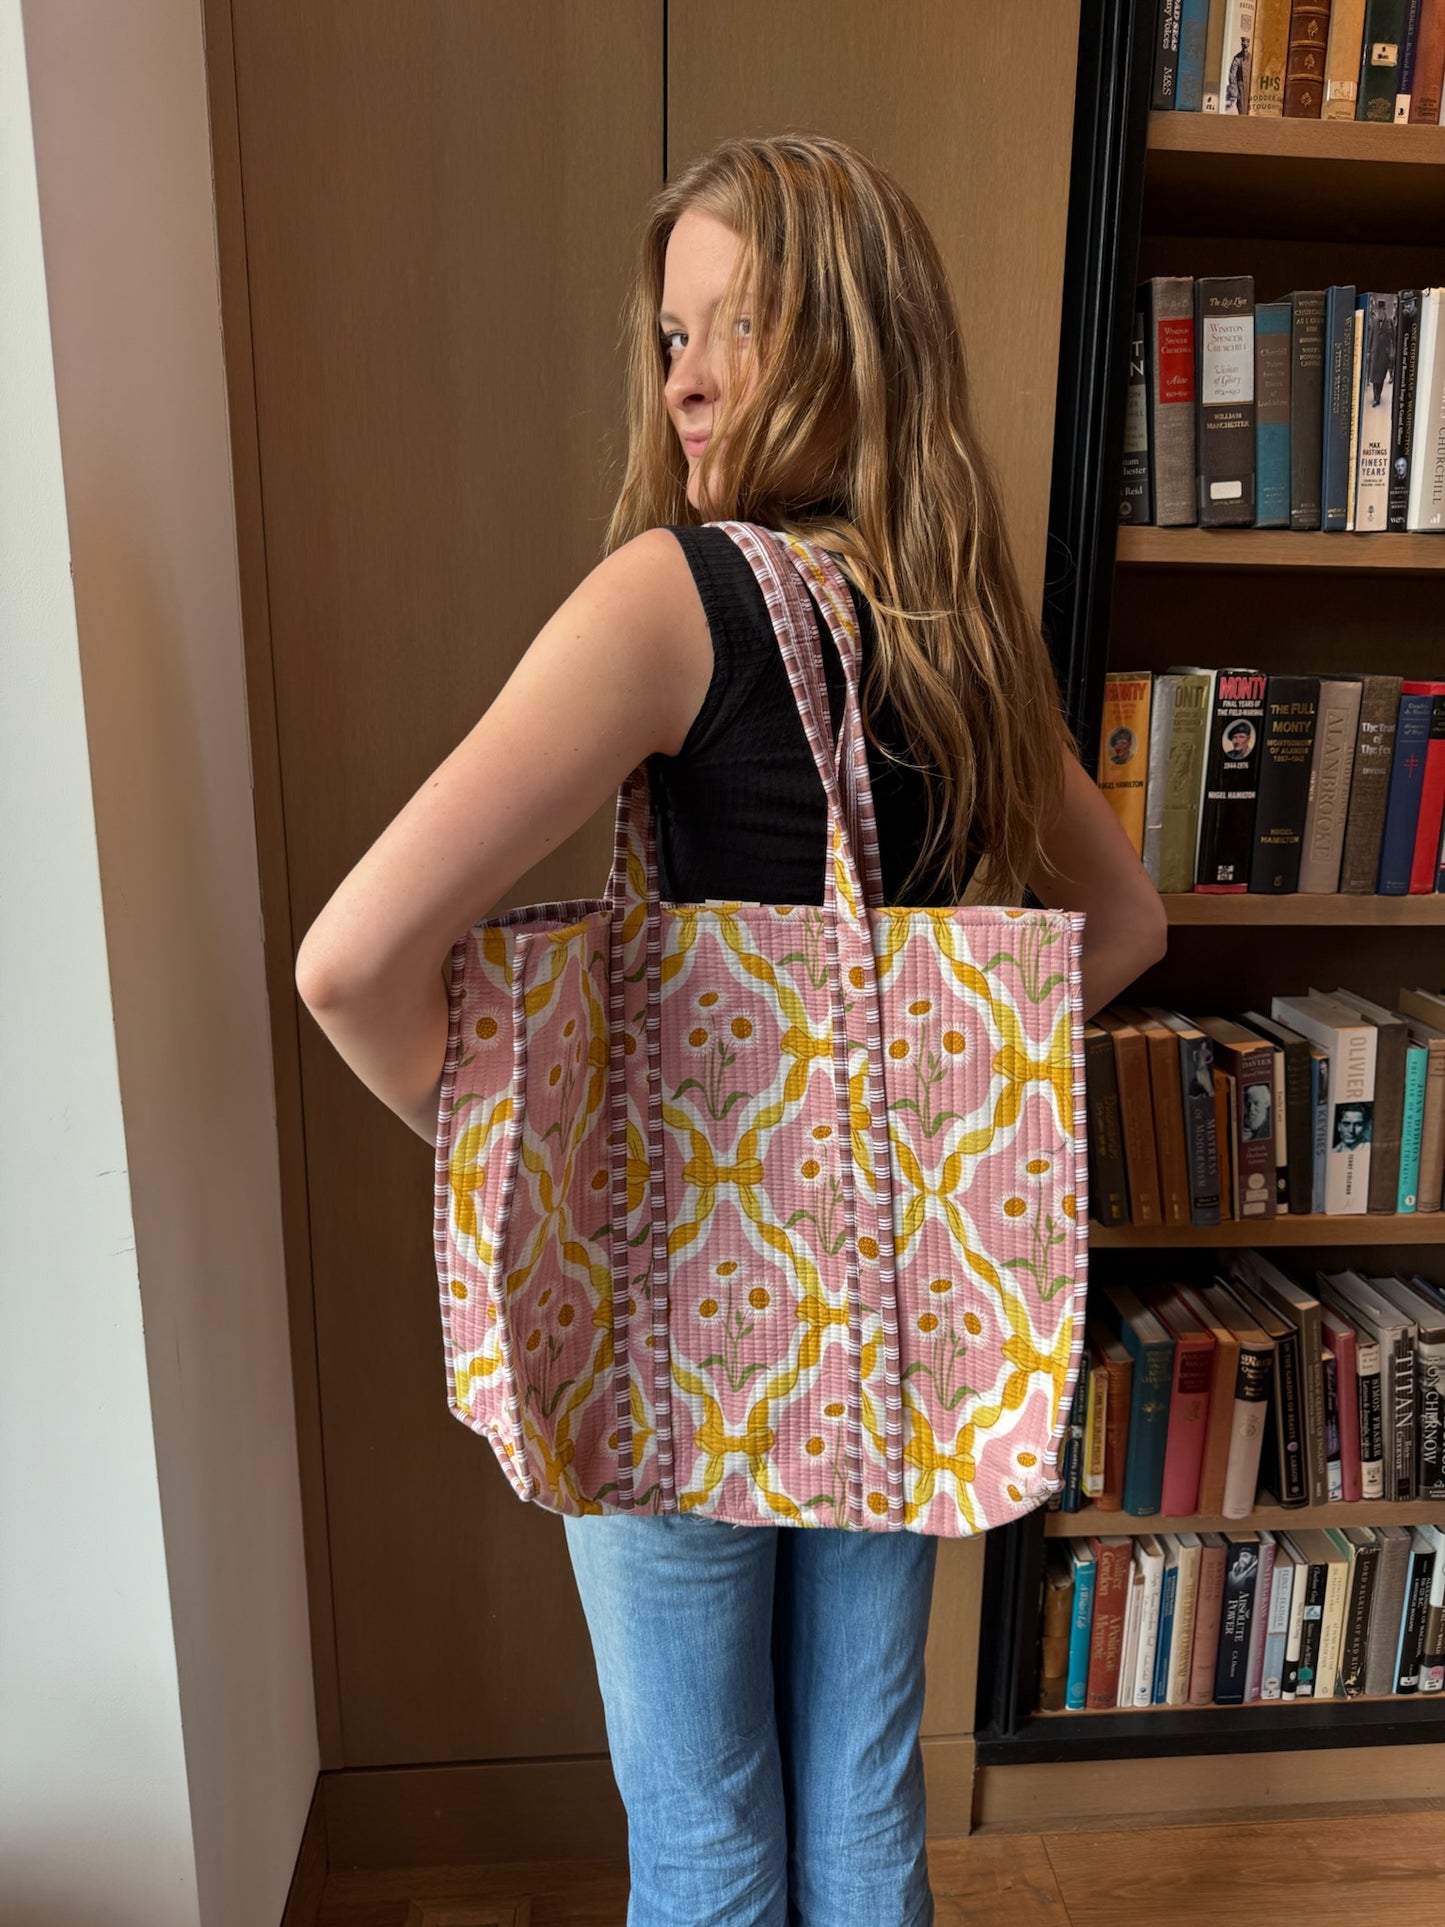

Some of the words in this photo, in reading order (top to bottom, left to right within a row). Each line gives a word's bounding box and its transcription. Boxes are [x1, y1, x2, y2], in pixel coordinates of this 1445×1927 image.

[1163, 17, 1174, 49] Voices
[1171, 21, 1180, 52] SEAS
[1162, 66, 1174, 96] M&S
[1260, 75, 1281, 92] H&S
[1164, 327, 1189, 335] WINSTON
[1210, 323, 1244, 333] WINSTON
[1211, 334, 1243, 343] SPENCER
[1161, 346, 1192, 354] CHURCHILL
[1165, 337, 1188, 345] SPENCER
[1207, 343, 1248, 353] CHURCHILL
[1343, 316, 1353, 371] WINSTON
[1408, 343, 1417, 391] CHRISTMAS
[1213, 376, 1220, 385] of
[1221, 375, 1241, 387] Glory
[1206, 420, 1249, 430] MANCHESTER
[1214, 412, 1242, 420] WILLIAM
[1404, 400, 1413, 456] WASHINGTON
[1361, 458, 1388, 467] FINEST
[1362, 468, 1386, 476] YEARS
[1432, 426, 1445, 505] CHURCHILL
[1125, 486, 1143, 496] Reid
[1219, 676, 1267, 700] MONTY
[1270, 704, 1289, 715] THE
[1291, 702, 1315, 714] FULL
[1272, 721, 1312, 733] MONTY
[1362, 722, 1378, 733] The
[1266, 739, 1312, 747] MONTGOMERY
[1361, 744, 1378, 755] The
[1116, 781, 1144, 789] HAMILTON
[1208, 791, 1226, 799] NIGEL
[1227, 791, 1256, 799] HAMILTON
[1316, 713, 1344, 859] ALANBROOKE
[1260, 836, 1300, 844] HAMILTON
[1270, 828, 1293, 836] NIGEL
[1242, 1059, 1272, 1069] DAVIES
[1345, 1035, 1367, 1099] OLIVIER
[1416, 1083, 1425, 1113] JOAN
[1316, 1109, 1327, 1156] KEYNES
[1412, 1119, 1422, 1162] DIDION
[1194, 1123, 1206, 1188] MODERNISM
[1206, 1118, 1217, 1175] MISTRESS
[1345, 1170, 1353, 1195] COLEMAN
[1427, 1356, 1440, 1387] RON
[1286, 1370, 1294, 1400] GARDEN
[1372, 1378, 1381, 1412] SIMON
[1395, 1350, 1414, 1428] TITAN
[1287, 1402, 1294, 1412] OF
[1287, 1414, 1296, 1440] BEASTS
[1317, 1426, 1324, 1436] OF
[1373, 1417, 1381, 1457] FRASER
[1424, 1391, 1438, 1465] CHERNOW
[1316, 1438, 1325, 1474] ENGLAND
[1290, 1455, 1298, 1483] LARSON
[1098, 1552, 1114, 1596] Gordon
[1280, 1569, 1289, 1590] FLINT
[1312, 1566, 1321, 1590] Charlotte
[1360, 1560, 1370, 1582] LORD
[1309, 1591, 1318, 1604] Gray
[1355, 1584, 1368, 1622] SELKIRK
[1410, 1581, 1419, 1607] HISTORICAL
[1421, 1577, 1432, 1614] ALEXANDER
[1224, 1599, 1237, 1635] POWER
[1233, 1591, 1250, 1642] ABSOLUTE
[1277, 1597, 1287, 1628] FEATHER
[1408, 1608, 1416, 1632] BIOGRAPHY
[1421, 1615, 1426, 1623] OF
[1094, 1614, 1109, 1660] Memoir
[1354, 1624, 1362, 1634] OF
[1106, 1624, 1120, 1672] Political
[1352, 1637, 1361, 1654] RED
[1436, 1633, 1444, 1655] WORLD
[1177, 1636, 1190, 1677] COMMAND
